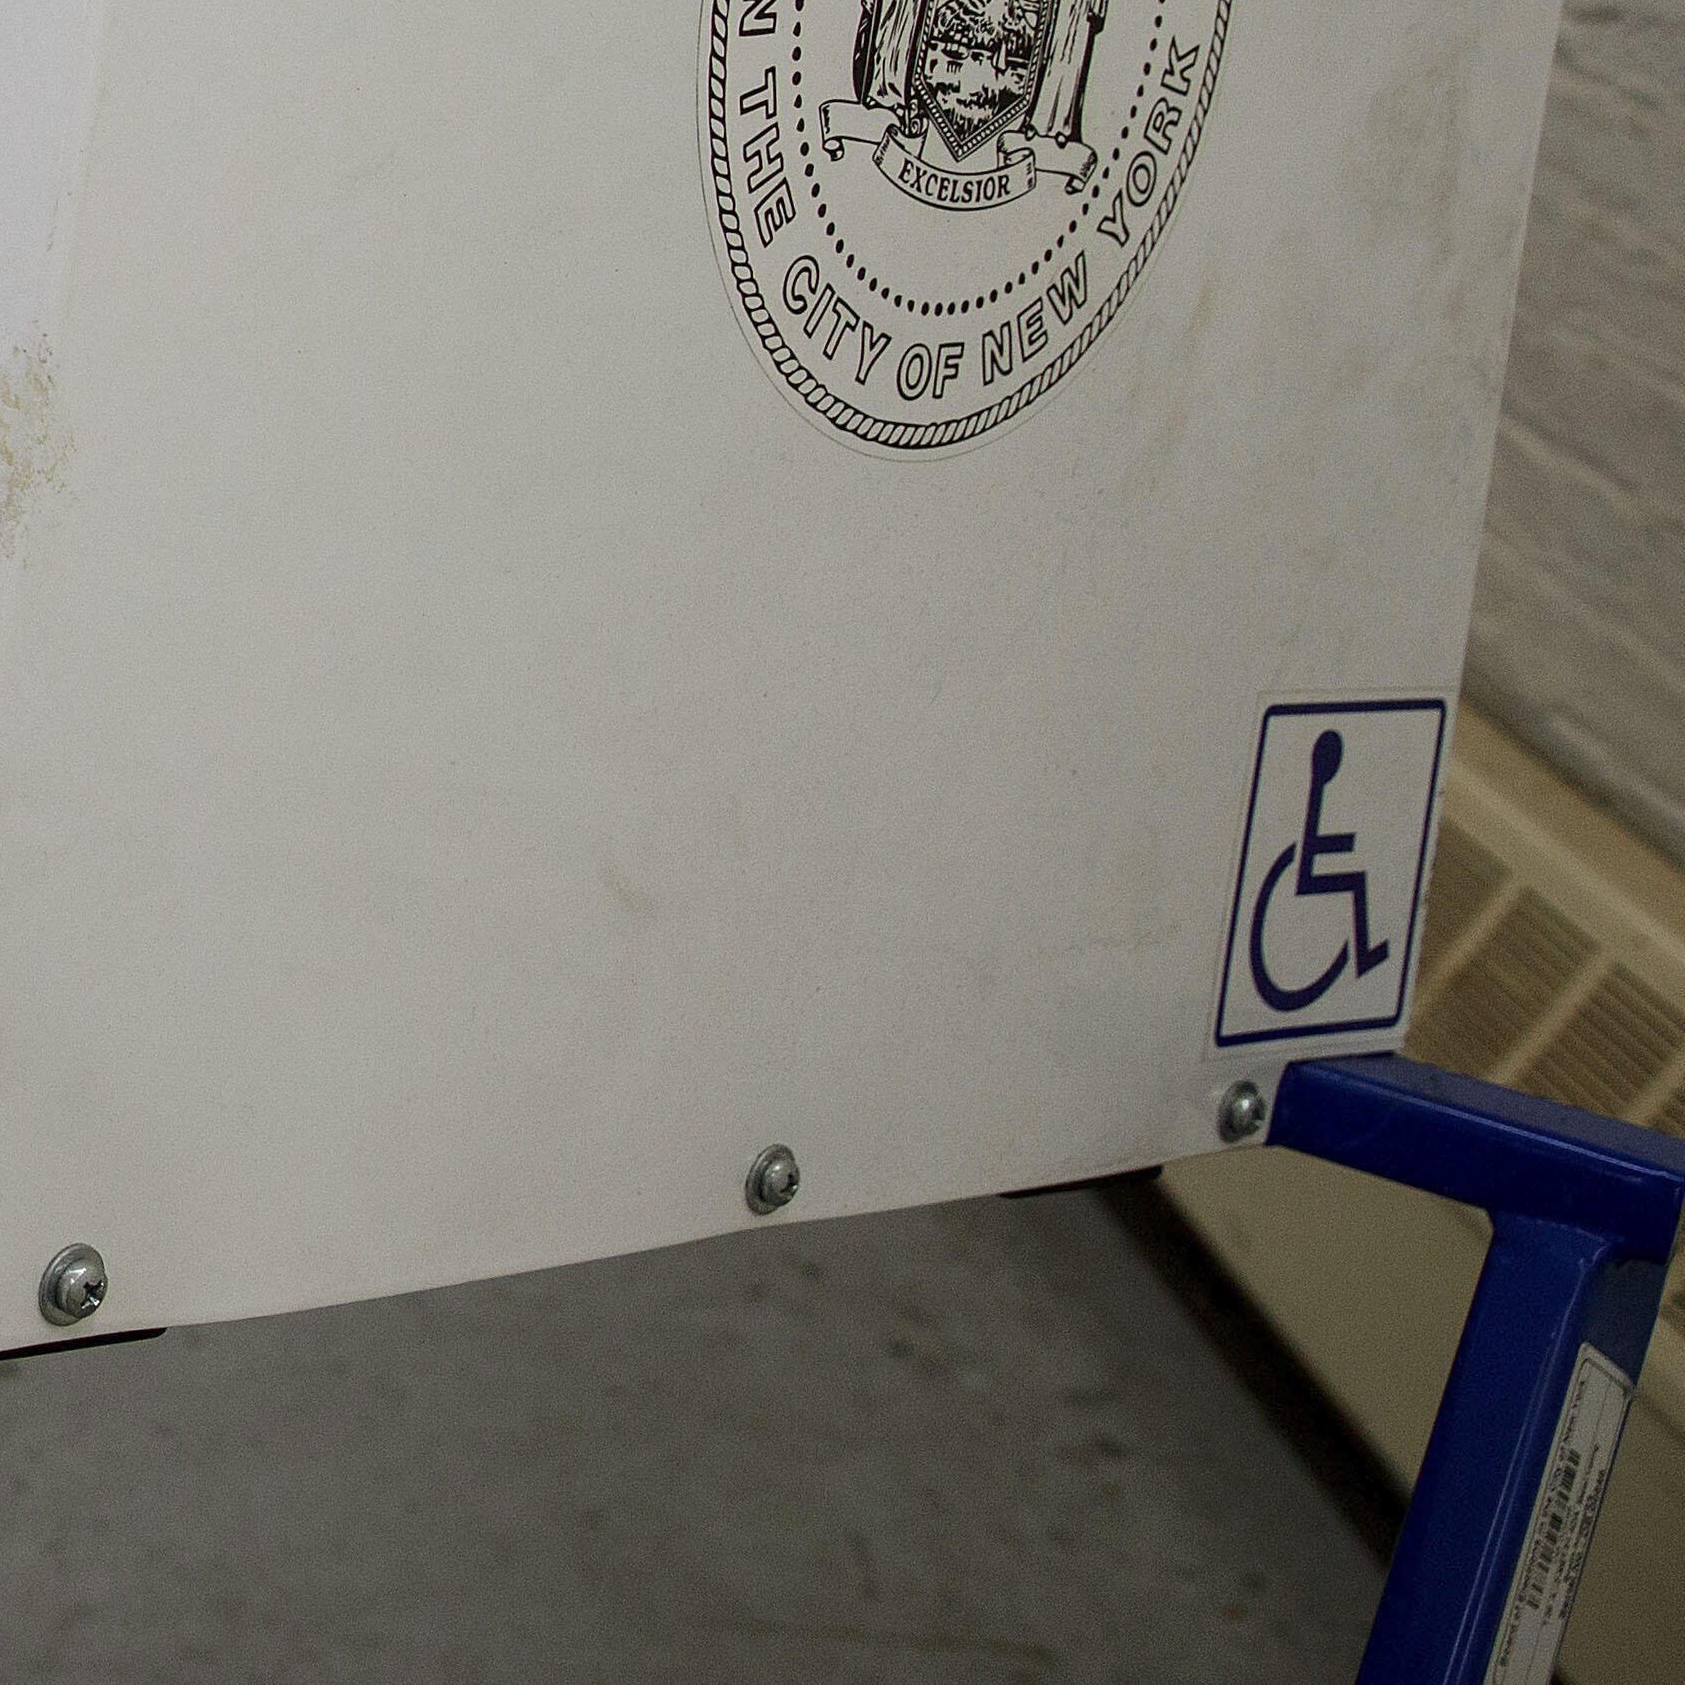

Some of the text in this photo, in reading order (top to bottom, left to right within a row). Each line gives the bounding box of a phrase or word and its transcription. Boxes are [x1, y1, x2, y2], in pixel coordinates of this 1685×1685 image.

[739, 66, 797, 248] THE
[782, 254, 892, 385] CITY
[896, 342, 965, 401] OF
[981, 250, 1087, 386] NEW
[1096, 35, 1200, 247] YORK
[898, 157, 1011, 204] EXCELSIOR
